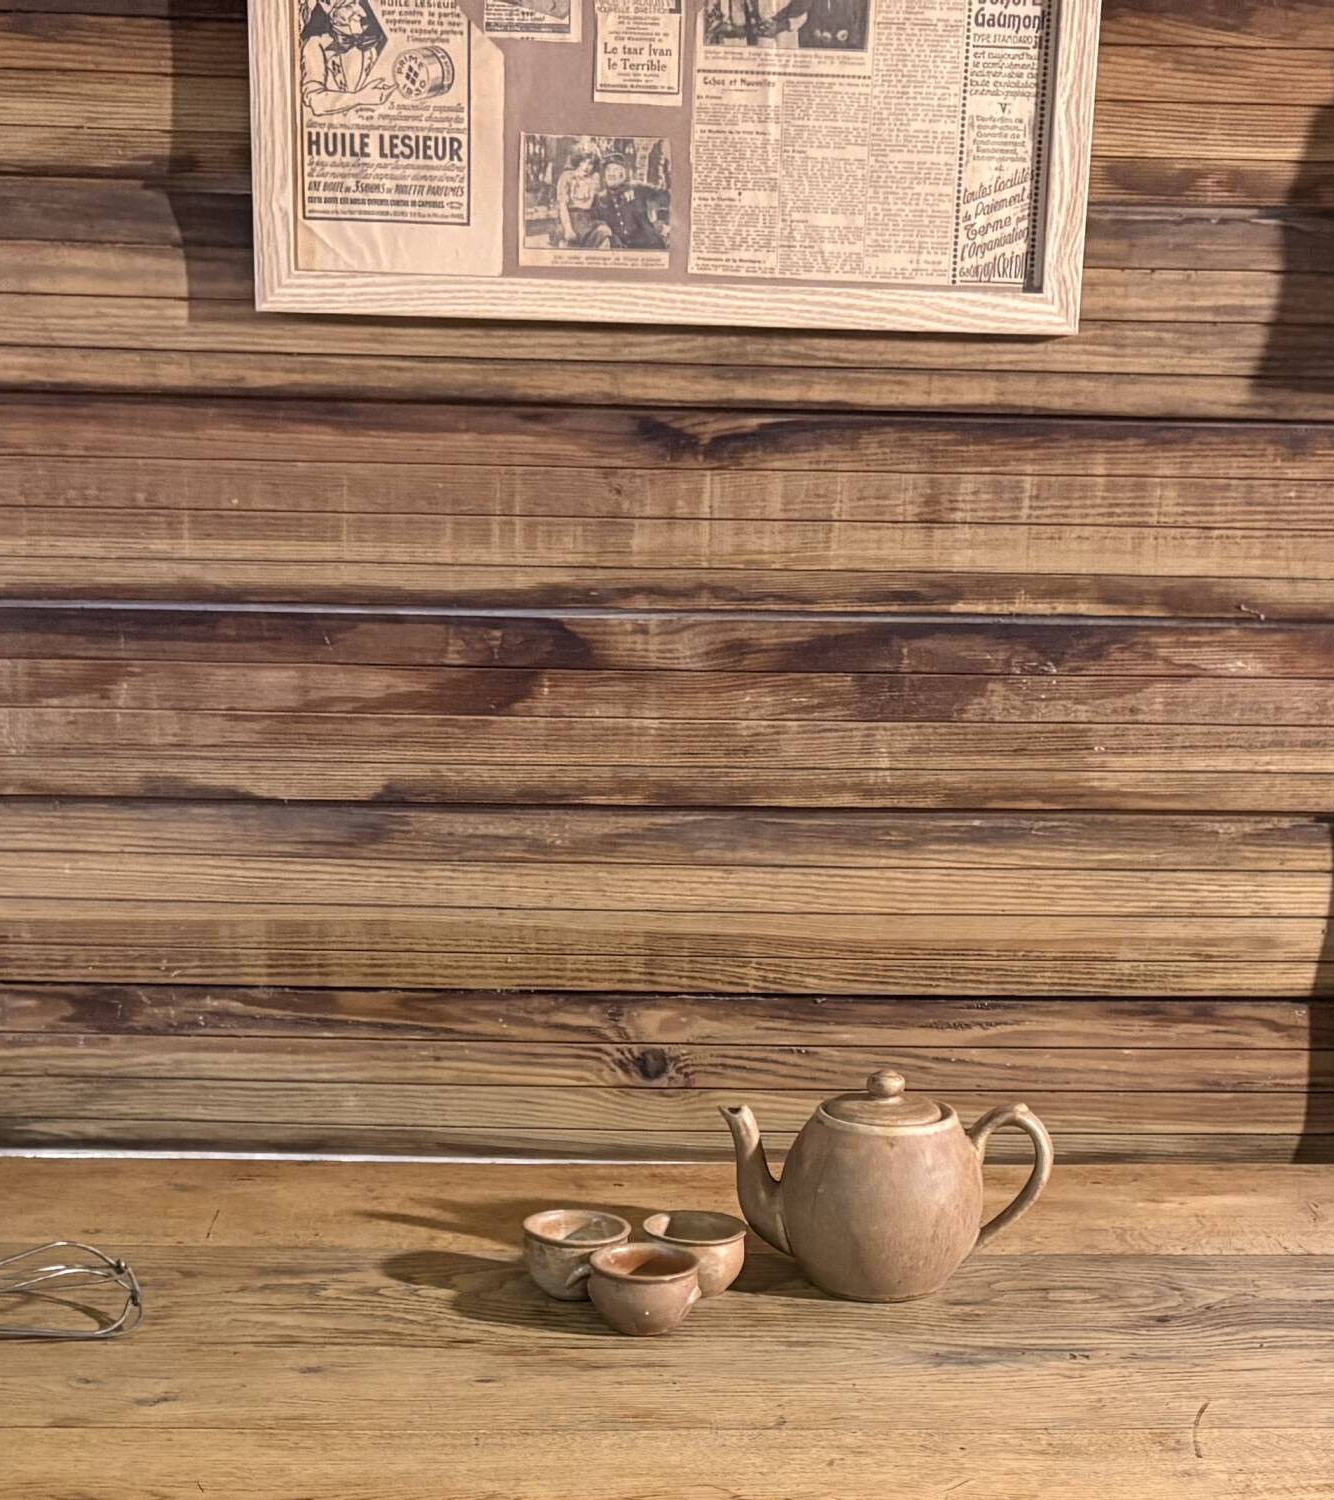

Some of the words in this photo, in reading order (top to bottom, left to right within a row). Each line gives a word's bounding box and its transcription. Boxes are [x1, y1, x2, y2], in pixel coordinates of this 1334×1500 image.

[604, 42, 618, 55] Le
[622, 45, 644, 55] tsar
[649, 43, 672, 57] Ivan
[607, 58, 618, 70] le
[620, 58, 668, 72] Terrible
[307, 131, 371, 158] HUILE
[379, 133, 463, 162] LESIEUR
[975, 186, 1026, 220] Paiement
